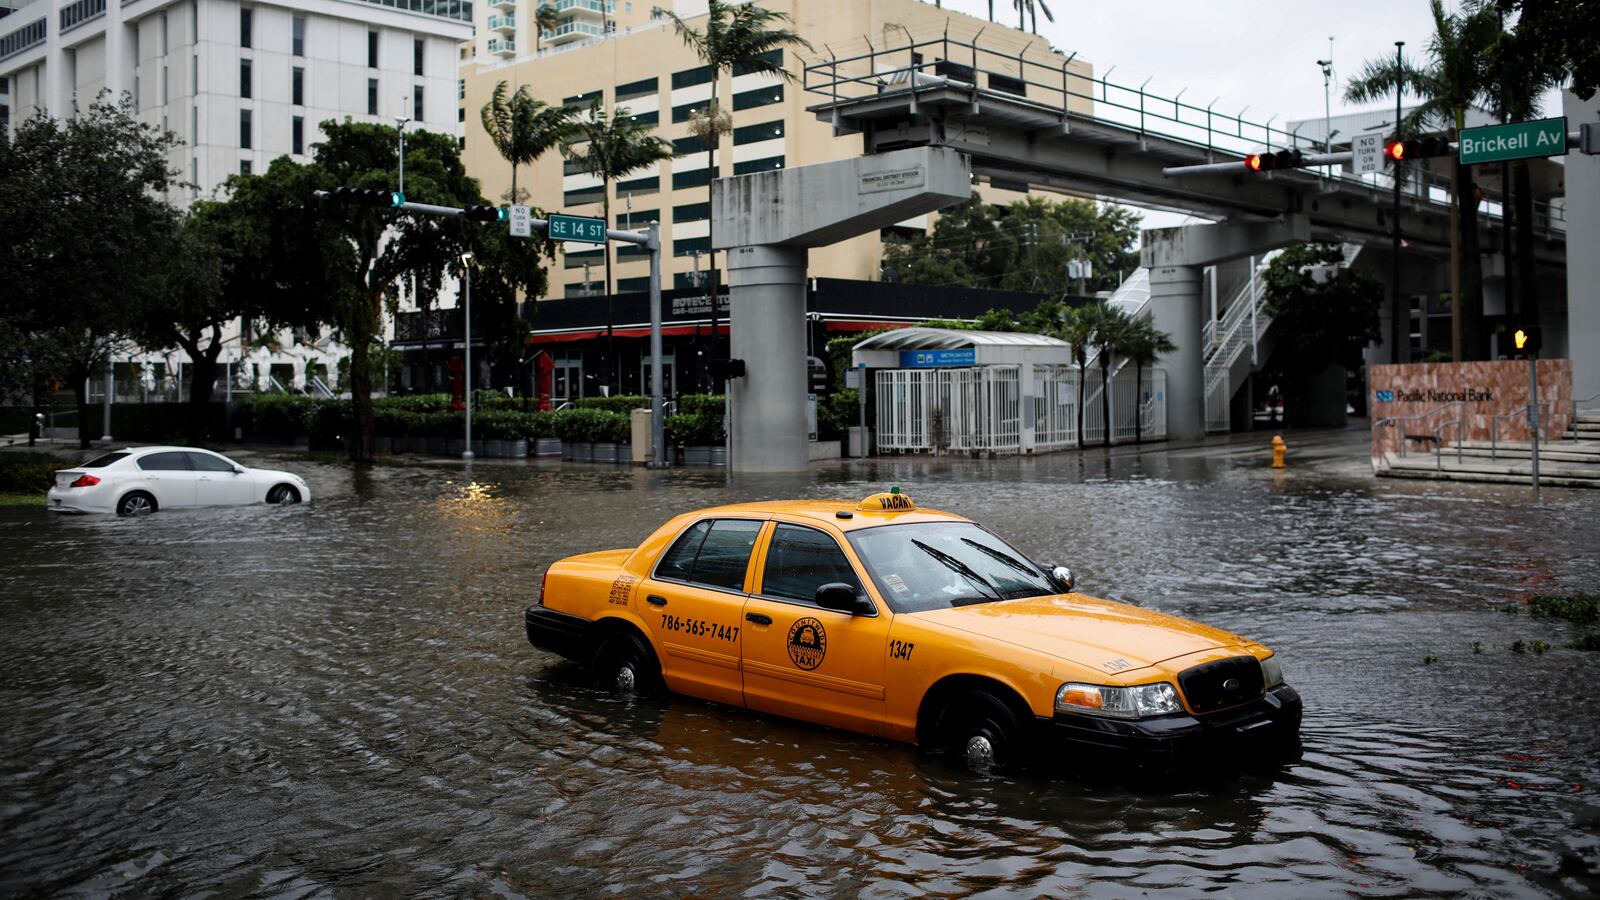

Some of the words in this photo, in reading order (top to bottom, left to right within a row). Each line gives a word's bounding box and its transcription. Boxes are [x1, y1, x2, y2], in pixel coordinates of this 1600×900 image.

[1360, 137, 1375, 146] NO
[1462, 132, 1528, 154] Brickell
[1536, 130, 1561, 147] Av
[1358, 147, 1376, 155] TURN
[1362, 163, 1375, 171] RED
[553, 221, 566, 233] SE
[572, 222, 584, 236] 14
[590, 225, 602, 236] ST
[1397, 388, 1426, 402] Pacific
[1427, 387, 1467, 402] National
[1468, 387, 1493, 402] Bank
[879, 494, 912, 509] VACANT
[661, 614, 739, 643] 786-565-7447
[889, 639, 915, 661] 1347
[795, 654, 816, 667] TAXI
